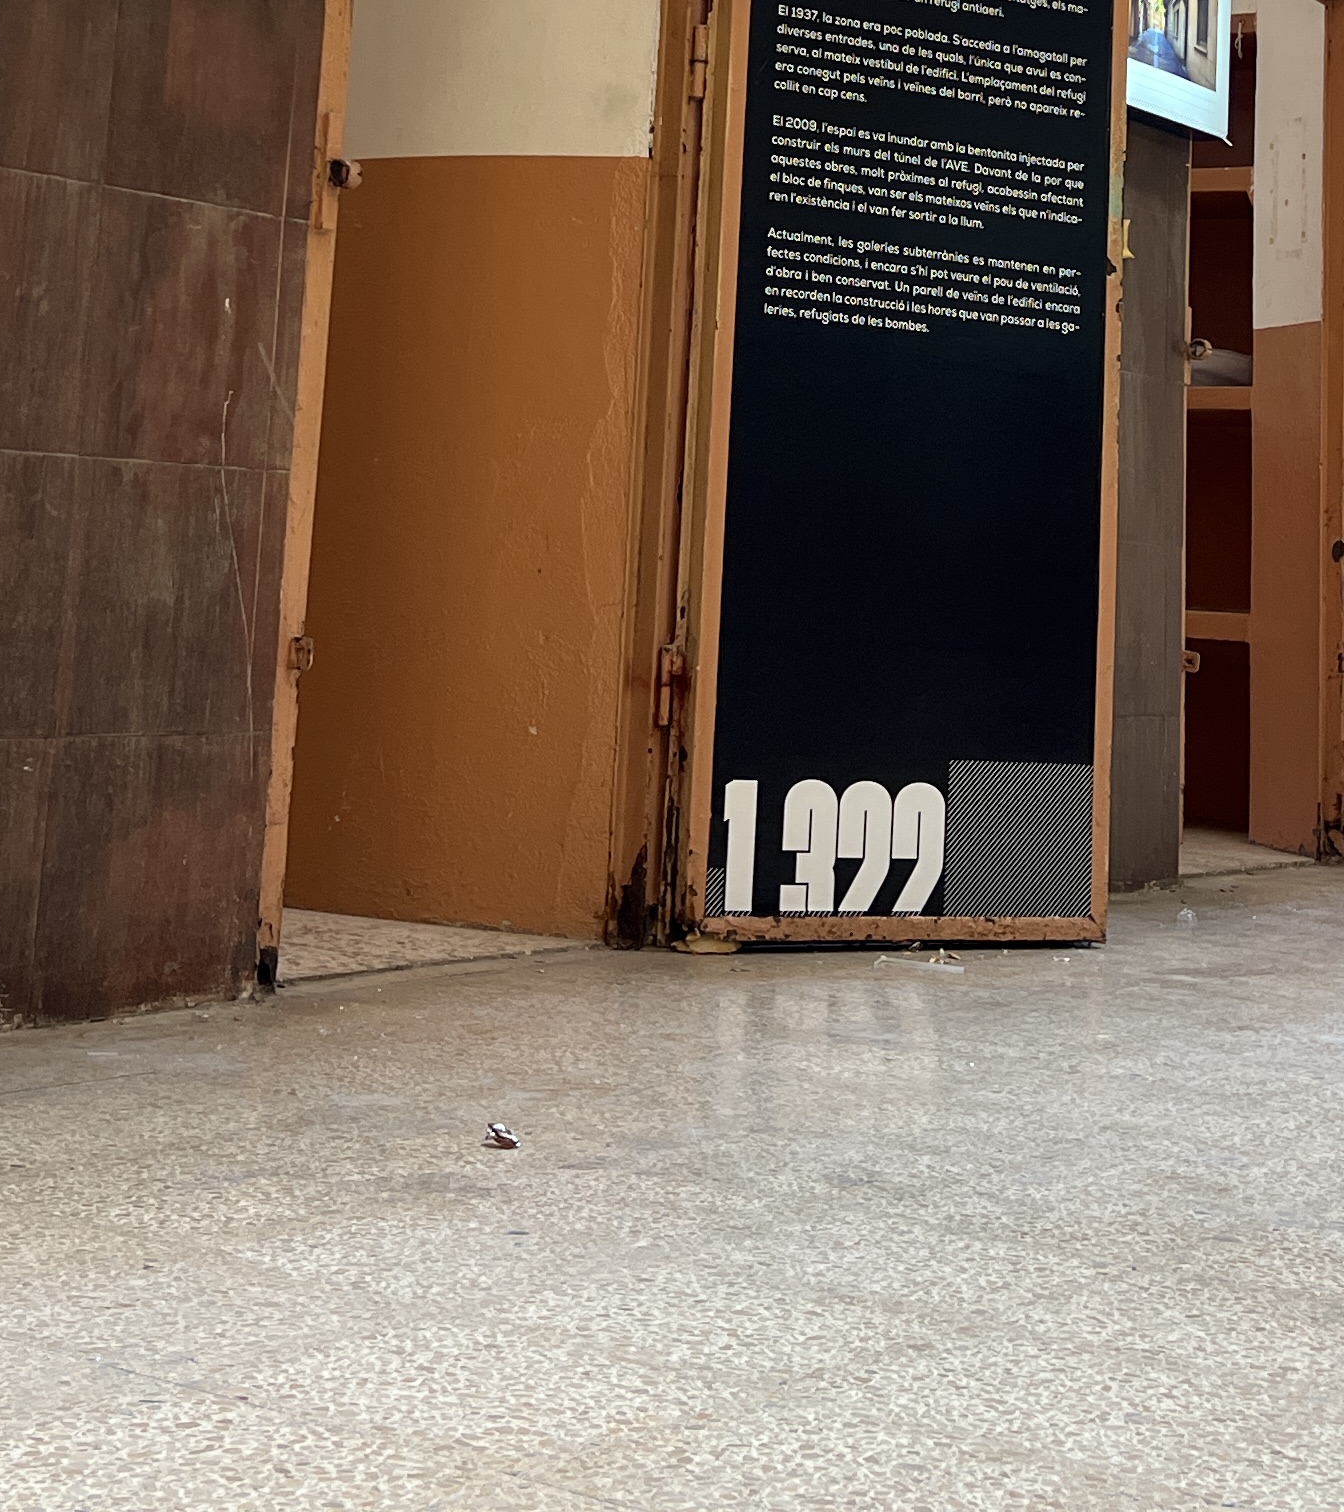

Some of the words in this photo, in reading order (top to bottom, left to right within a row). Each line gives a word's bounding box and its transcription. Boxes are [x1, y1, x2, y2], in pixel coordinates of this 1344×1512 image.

[774, 80, 800, 92] collit
[802, 84, 815, 94] en
[818, 87, 838, 100] cap
[840, 90, 867, 102] cens.
[764, 303, 796, 318] leries,
[799, 308, 849, 324] refugiats
[851, 314, 865, 325] de
[867, 316, 883, 327] les
[885, 317, 929, 332] bombes.
